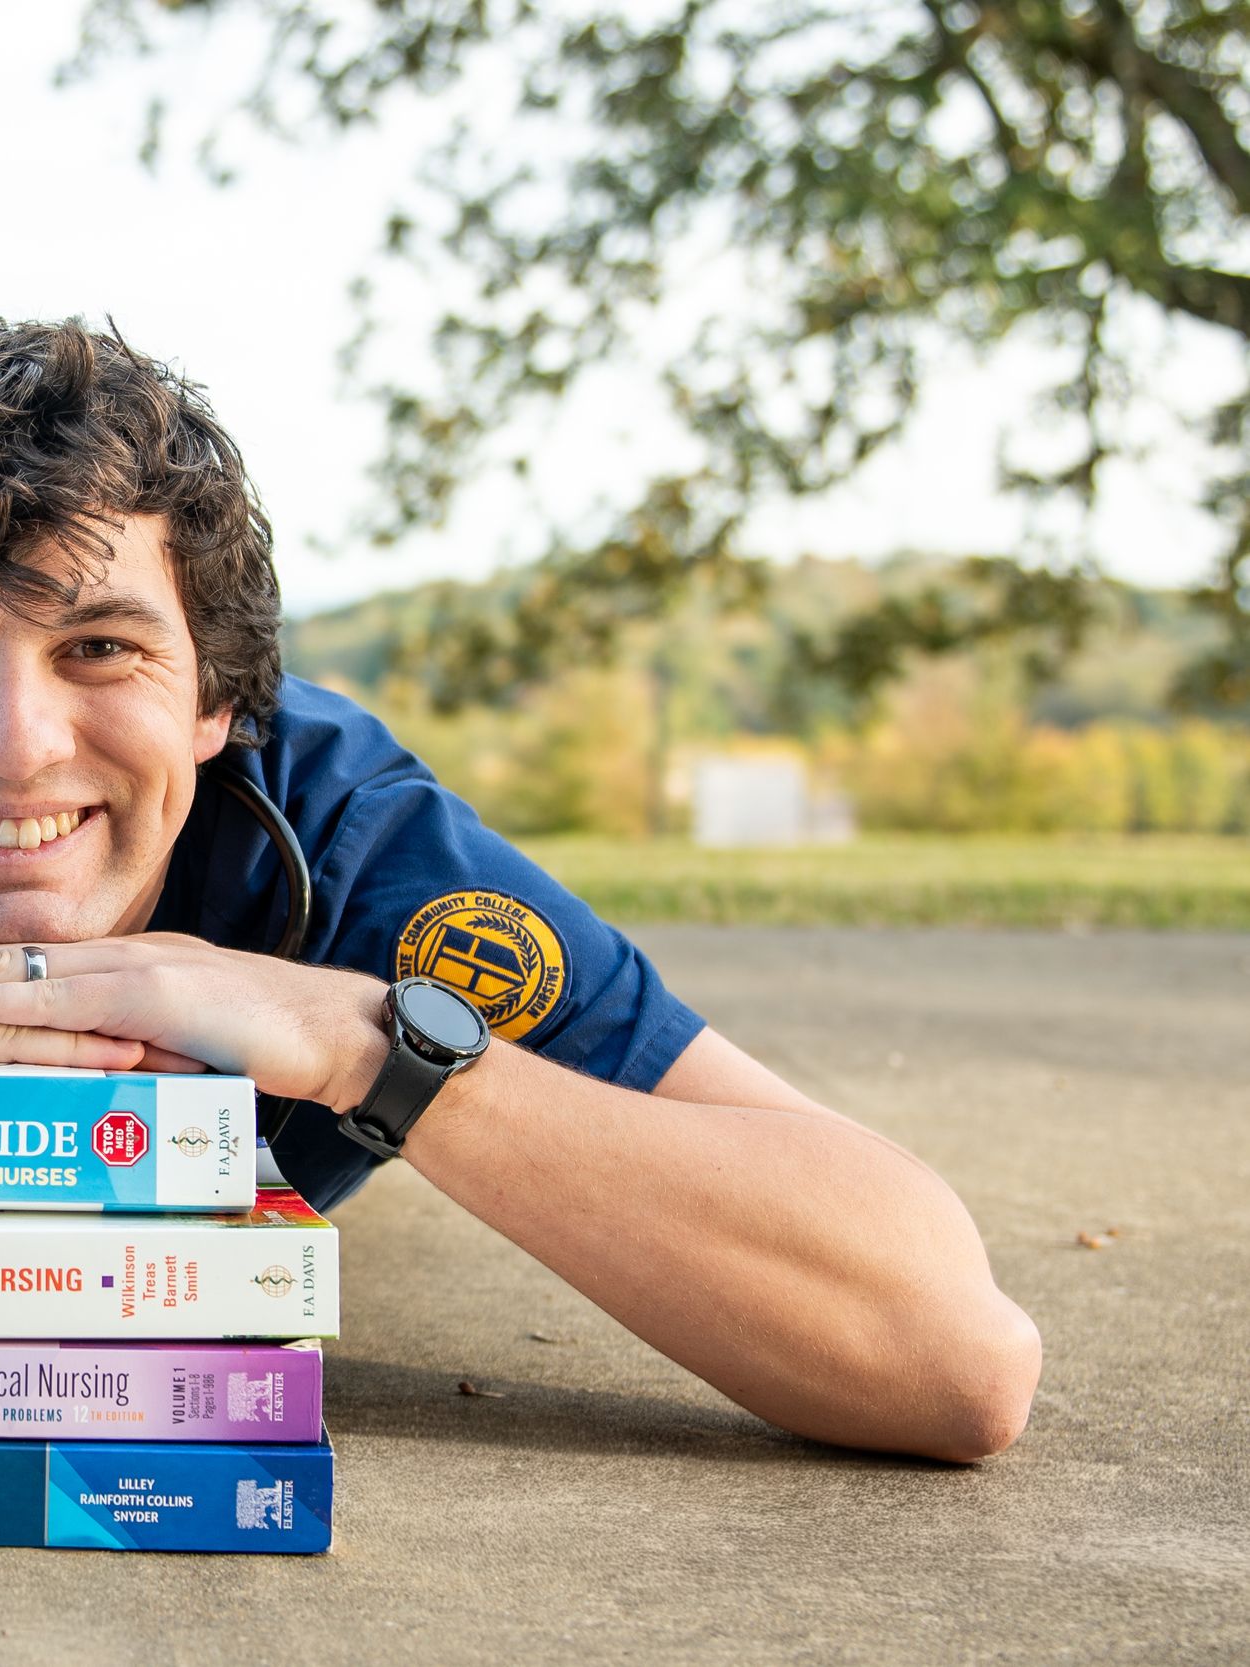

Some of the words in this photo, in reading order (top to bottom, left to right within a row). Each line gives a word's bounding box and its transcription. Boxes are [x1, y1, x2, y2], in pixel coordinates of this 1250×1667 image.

[403, 896, 466, 946] COMMUNITY
[475, 896, 529, 922] COLLEGE
[527, 965, 560, 1020] NURSING
[103, 1122, 114, 1155] STOP
[116, 1129, 124, 1149] MED
[126, 1120, 135, 1158] ERRORS
[219, 1108, 230, 1150] DAVIS
[122, 1245, 135, 1318] Wilkinson
[143, 1262, 156, 1301] Treas
[164, 1255, 177, 1308] Barnett
[185, 1261, 198, 1302] Smith
[303, 1245, 315, 1289] DAVIS
[39, 1363, 129, 1407] Nursing
[172, 1376, 186, 1425] VOLUME
[188, 1387, 200, 1419] Sections
[274, 1372, 284, 1422] ELSEVIER
[3, 1408, 63, 1422] PROBLEMS
[106, 1410, 144, 1422] EDITION
[203, 1397, 217, 1419] Pages
[80, 1493, 144, 1507] RAINFORTH
[146, 1495, 194, 1508] COLLINS
[118, 1478, 155, 1491] LILLEY
[283, 1480, 294, 1530] ELSEVIER
[113, 1511, 159, 1523] SNYDER
